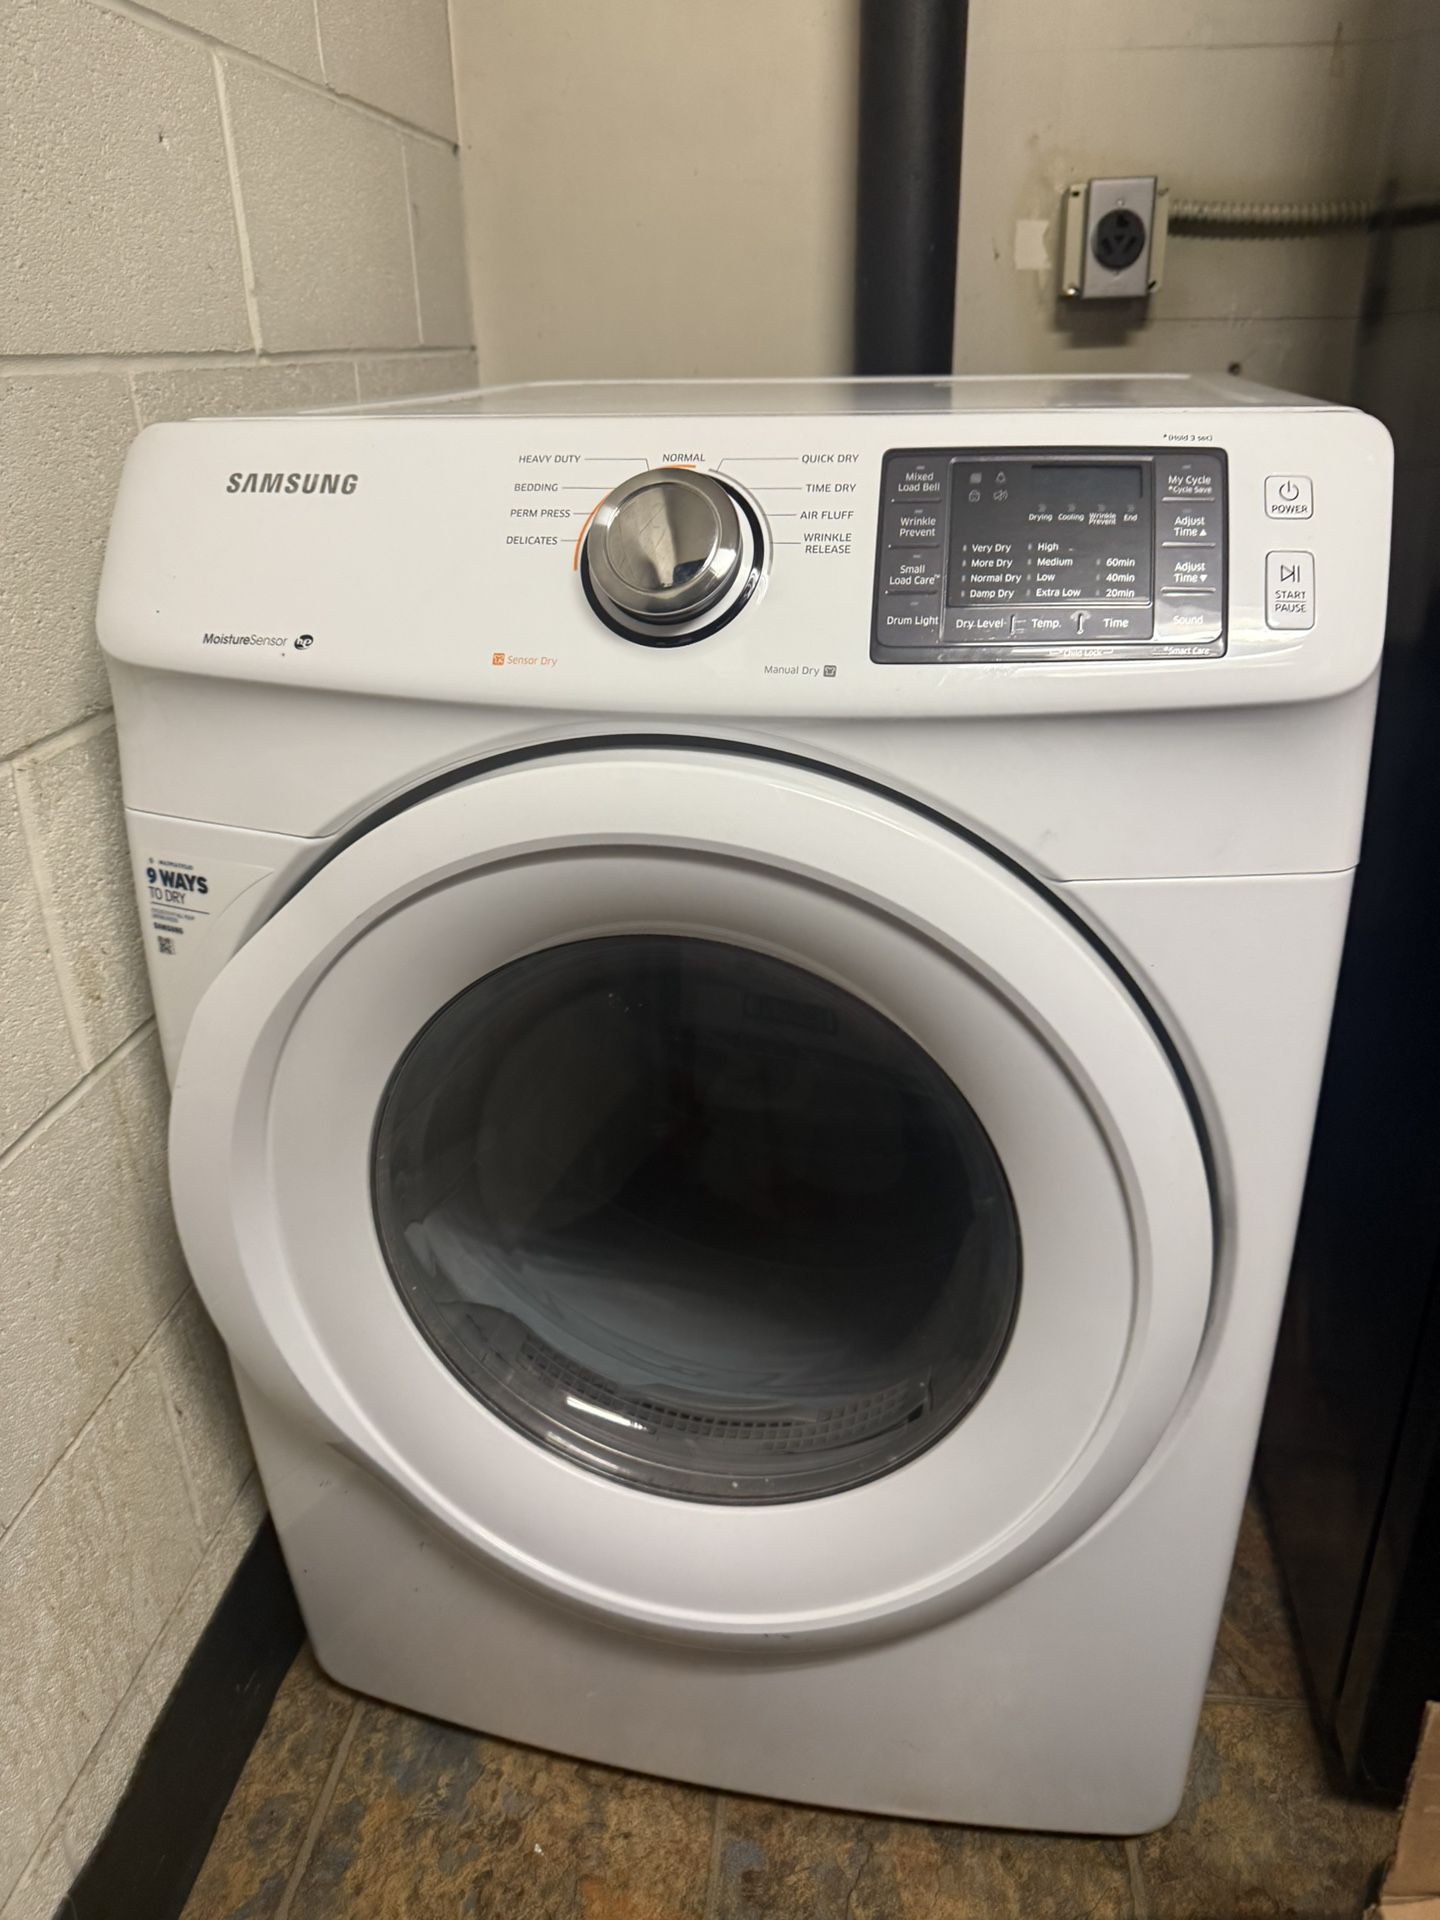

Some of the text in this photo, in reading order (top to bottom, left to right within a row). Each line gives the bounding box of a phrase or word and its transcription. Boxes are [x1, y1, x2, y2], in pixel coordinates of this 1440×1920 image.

[518, 454, 581, 464] HEAVY DUTY
[662, 453, 706, 463] NORMAL
[801, 454, 860, 464] QUICK DRY
[905, 472, 934, 482] Mixed
[1168, 475, 1212, 486] My Cycle
[226, 472, 359, 495] SAMSUNG
[514, 483, 558, 493] BEDDING
[806, 483, 857, 493] TIME DRY
[898, 482, 940, 492] Load Bell
[1194, 486, 1213, 494] Save
[510, 509, 571, 519] PERM PRESS
[1271, 505, 1308, 514] POWER
[800, 511, 855, 520] AIR FLUFF
[1028, 513, 1053, 522] Drying
[1057, 513, 1085, 522] Cooling
[1123, 514, 1138, 522] End
[900, 517, 936, 527] Wrinkle
[1174, 516, 1205, 528] Adjust
[899, 528, 936, 538] Prevent
[1174, 527, 1198, 537] Time
[506, 536, 558, 546] DELICATES
[804, 533, 852, 543] WRINKLE
[805, 544, 851, 555] RELEASE
[971, 544, 1012, 554] Very Dry
[1037, 542, 1059, 552] High
[971, 559, 1013, 569] More Dry
[1037, 558, 1073, 567] Medium
[1106, 558, 1136, 567] 60min
[900, 565, 925, 574] Small
[1174, 562, 1206, 574] Adjust
[889, 575, 912, 585] Load
[970, 573, 1022, 584] Normal Dry
[1036, 573, 1056, 582] Low
[1105, 573, 1136, 583] 40min
[1174, 573, 1198, 584] Time
[969, 589, 1015, 599] Damp Dry
[1036, 588, 1081, 597] Extra Low
[1105, 588, 1136, 598] 20min
[1275, 590, 1306, 600] START
[1275, 603, 1307, 614] PAUSE
[886, 616, 939, 627] Drum Light
[955, 619, 1004, 630] Dry Level
[1031, 618, 1062, 629] Temp.
[1103, 618, 1130, 628] Time
[1172, 615, 1204, 625] Sound
[507, 655, 558, 668] Sensor Dry
[764, 665, 821, 678] Manual Dry
[147, 867, 208, 894] 9 WAYS
[148, 886, 186, 904] TO DRY
